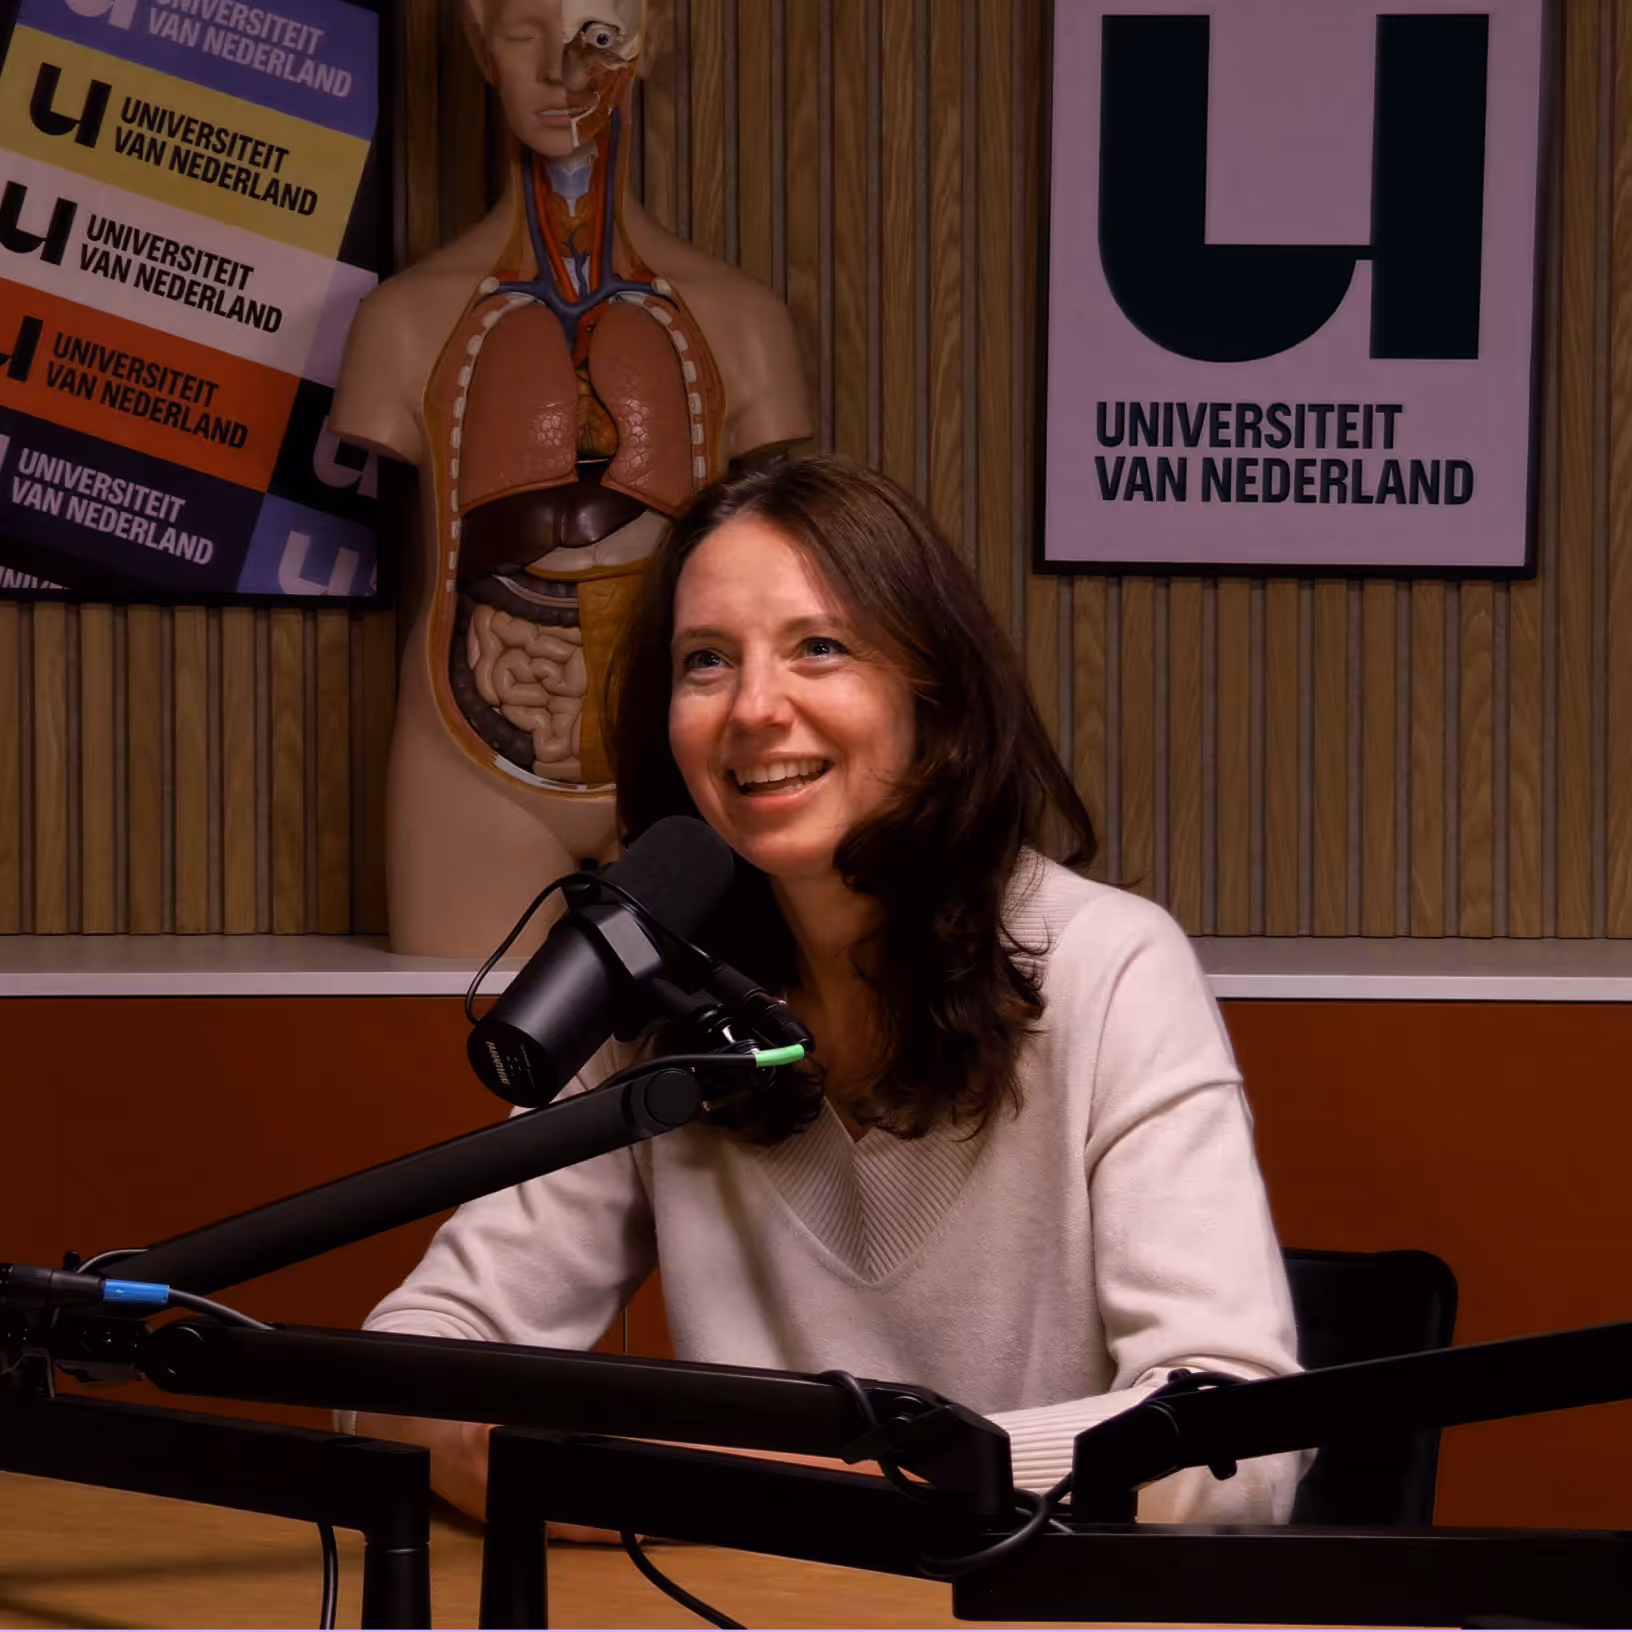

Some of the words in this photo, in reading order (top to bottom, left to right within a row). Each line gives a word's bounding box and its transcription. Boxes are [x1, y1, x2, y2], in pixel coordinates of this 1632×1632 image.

[150, 7, 201, 48] VAN
[202, 28, 352, 98] NEDERLAND
[156, 0, 325, 56] IVERSITEIT
[115, 126, 167, 167] VAN
[171, 146, 318, 217] NEDERLAND
[121, 96, 289, 173] UNIVERSITEIT
[81, 244, 132, 284] VAN
[135, 263, 283, 333] NEDERLAND
[87, 213, 254, 291] UNIVERSITEIT
[46, 362, 99, 402] VAN
[101, 382, 248, 449] NEDERLAND
[53, 332, 219, 407] UNIVERSITEIT
[1096, 401, 1403, 449] UNIVERSITEIT
[18, 447, 186, 523] UNIVERSITEIT
[1094, 456, 1187, 501] VAN
[1201, 457, 1474, 505] NEDERLAND
[12, 477, 64, 516] VAN
[65, 497, 214, 566] NEDERLAND
